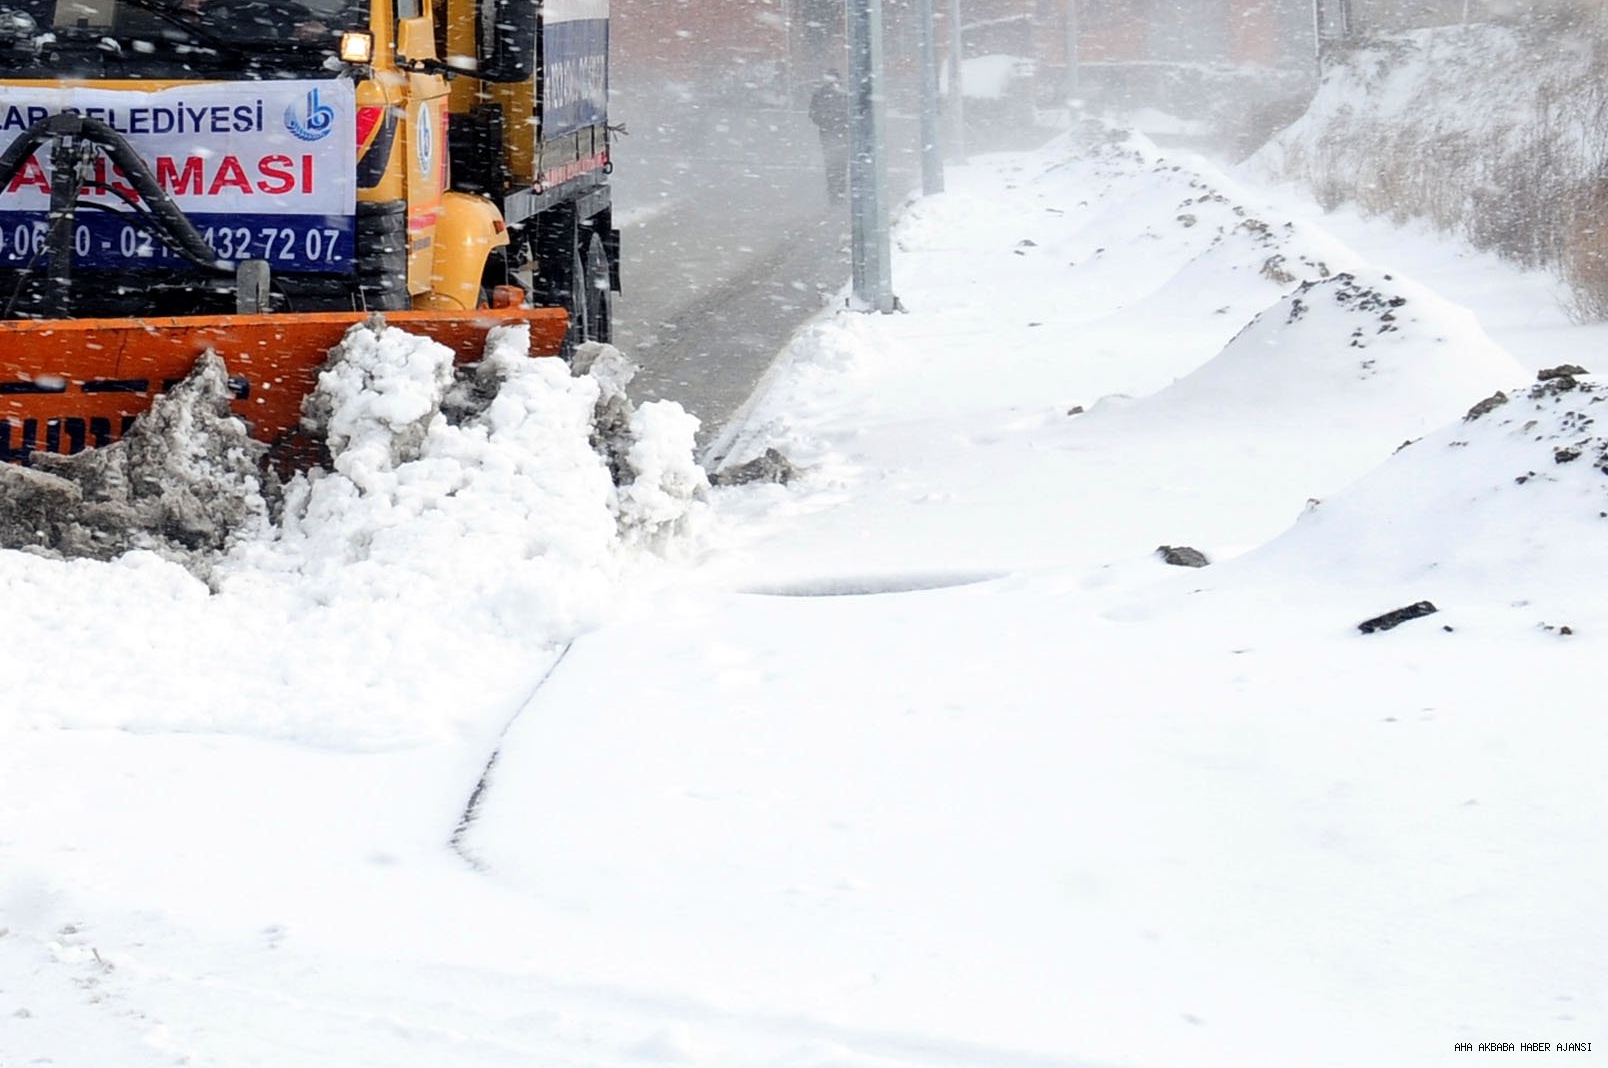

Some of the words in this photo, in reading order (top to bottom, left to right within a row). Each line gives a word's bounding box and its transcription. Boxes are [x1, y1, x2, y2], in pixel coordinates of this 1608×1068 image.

[61, 100, 264, 135] ELEDİYESİ
[262, 228, 296, 260] 72
[305, 228, 340, 261] 07
